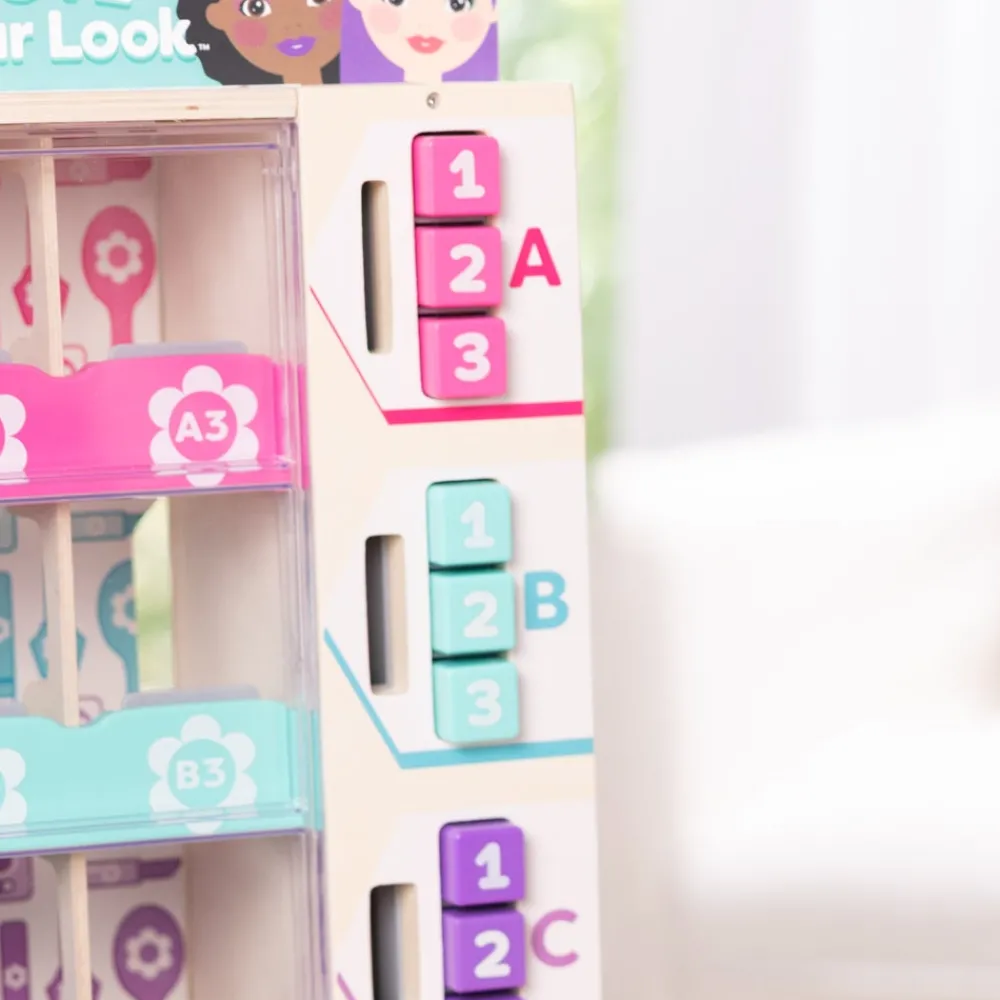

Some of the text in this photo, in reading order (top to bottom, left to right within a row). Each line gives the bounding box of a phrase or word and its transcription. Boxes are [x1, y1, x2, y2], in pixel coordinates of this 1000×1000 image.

[449, 149, 486, 199] 1
[449, 243, 487, 293] 2
[509, 227, 562, 288] A
[453, 332, 491, 382] 3
[175, 409, 229, 443] A3
[460, 501, 496, 549] 1
[463, 590, 499, 638] 2
[523, 570, 569, 631] B
[466, 678, 502, 726] 3
[176, 757, 227, 791] B3
[474, 841, 511, 890] 1
[474, 930, 511, 979] 2
[531, 908, 579, 967] C
